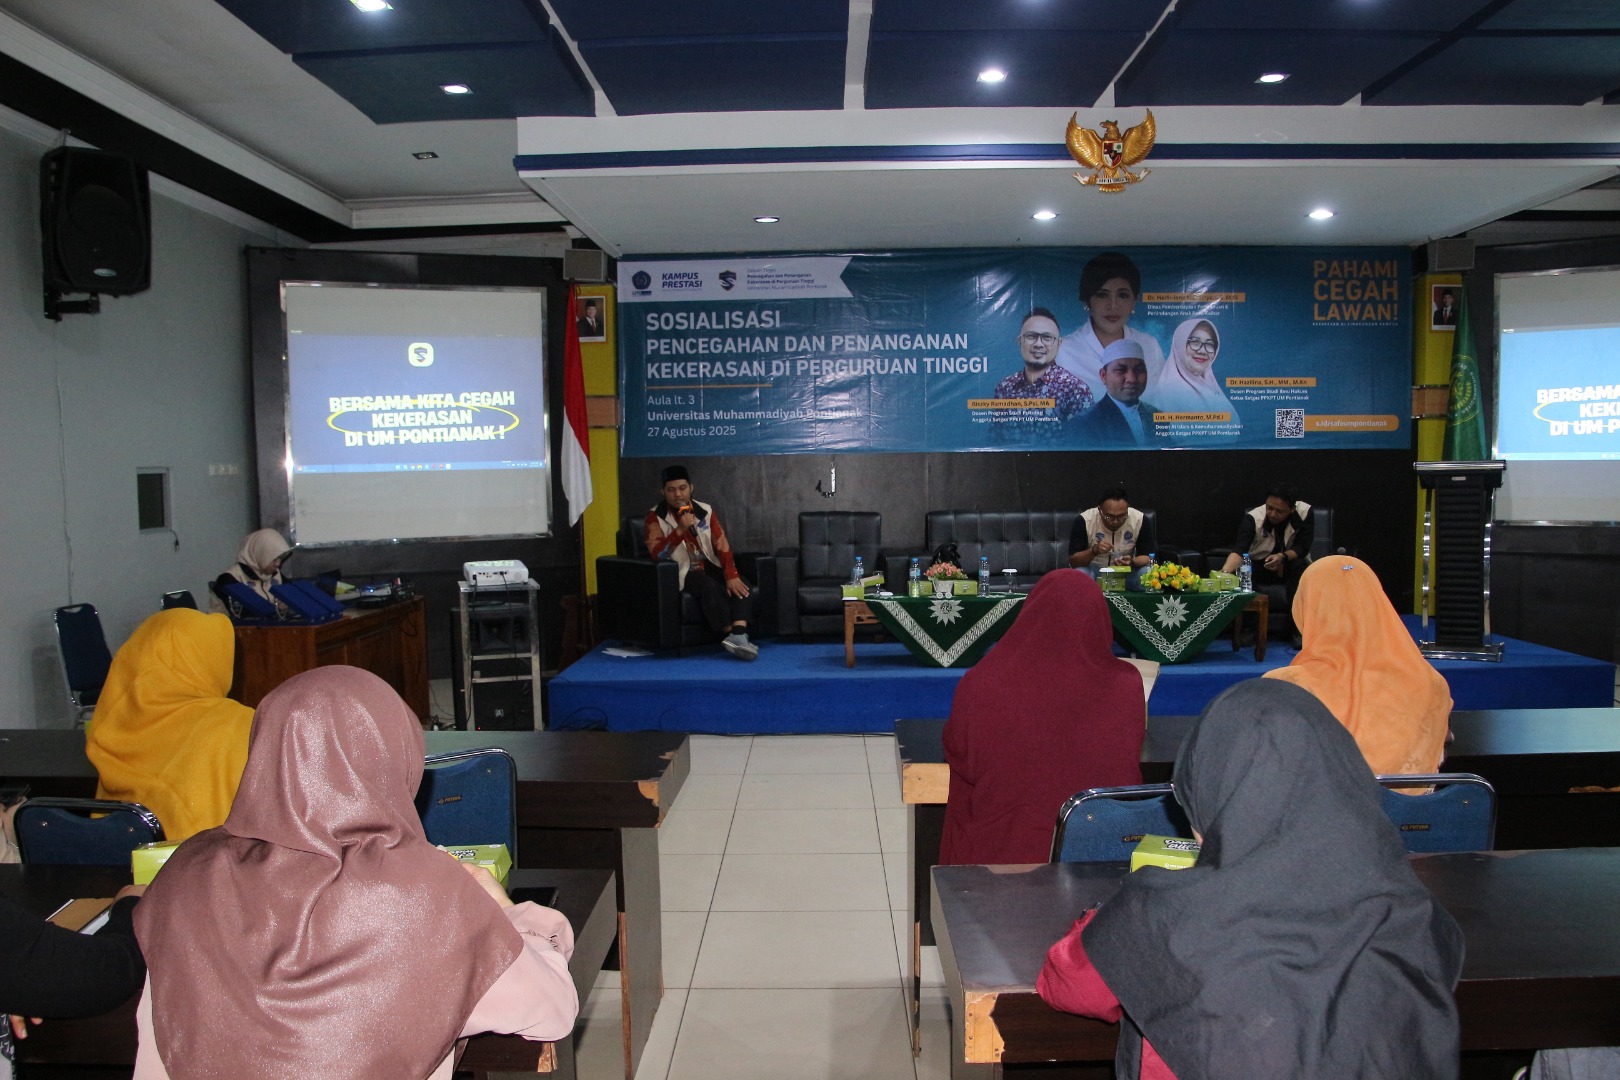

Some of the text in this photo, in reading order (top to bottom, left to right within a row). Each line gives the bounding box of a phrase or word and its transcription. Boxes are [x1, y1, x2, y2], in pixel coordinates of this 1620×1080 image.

[662, 272, 699, 281] KAMPUS
[1313, 260, 1398, 278] PAHAMI
[662, 280, 703, 289] PRESTASI
[1313, 279, 1398, 301] CEGAH
[646, 310, 781, 331] SOSIALISASI
[1313, 302, 1399, 321] LAWAN!
[646, 333, 968, 355] PENCEGAHAN DAN PENANGANAN
[647, 357, 988, 379] KEKERASAN DI PERGURUAN TINGGI
[329, 390, 515, 413] BERSAMA KITA CEGAH
[647, 395, 672, 405] Aula
[688, 395, 695, 405] 3
[372, 409, 473, 428] KEKERASAN
[647, 410, 711, 422] Universitas
[713, 408, 803, 421] Muhammadiyah
[345, 431, 363, 447] DI
[367, 430, 395, 446] UM
[399, 425, 496, 445] PONTIANAK
[647, 425, 736, 438] 27 Agustus 2025
[1549, 421, 1569, 436] DI
[1573, 419, 1603, 435] UM
